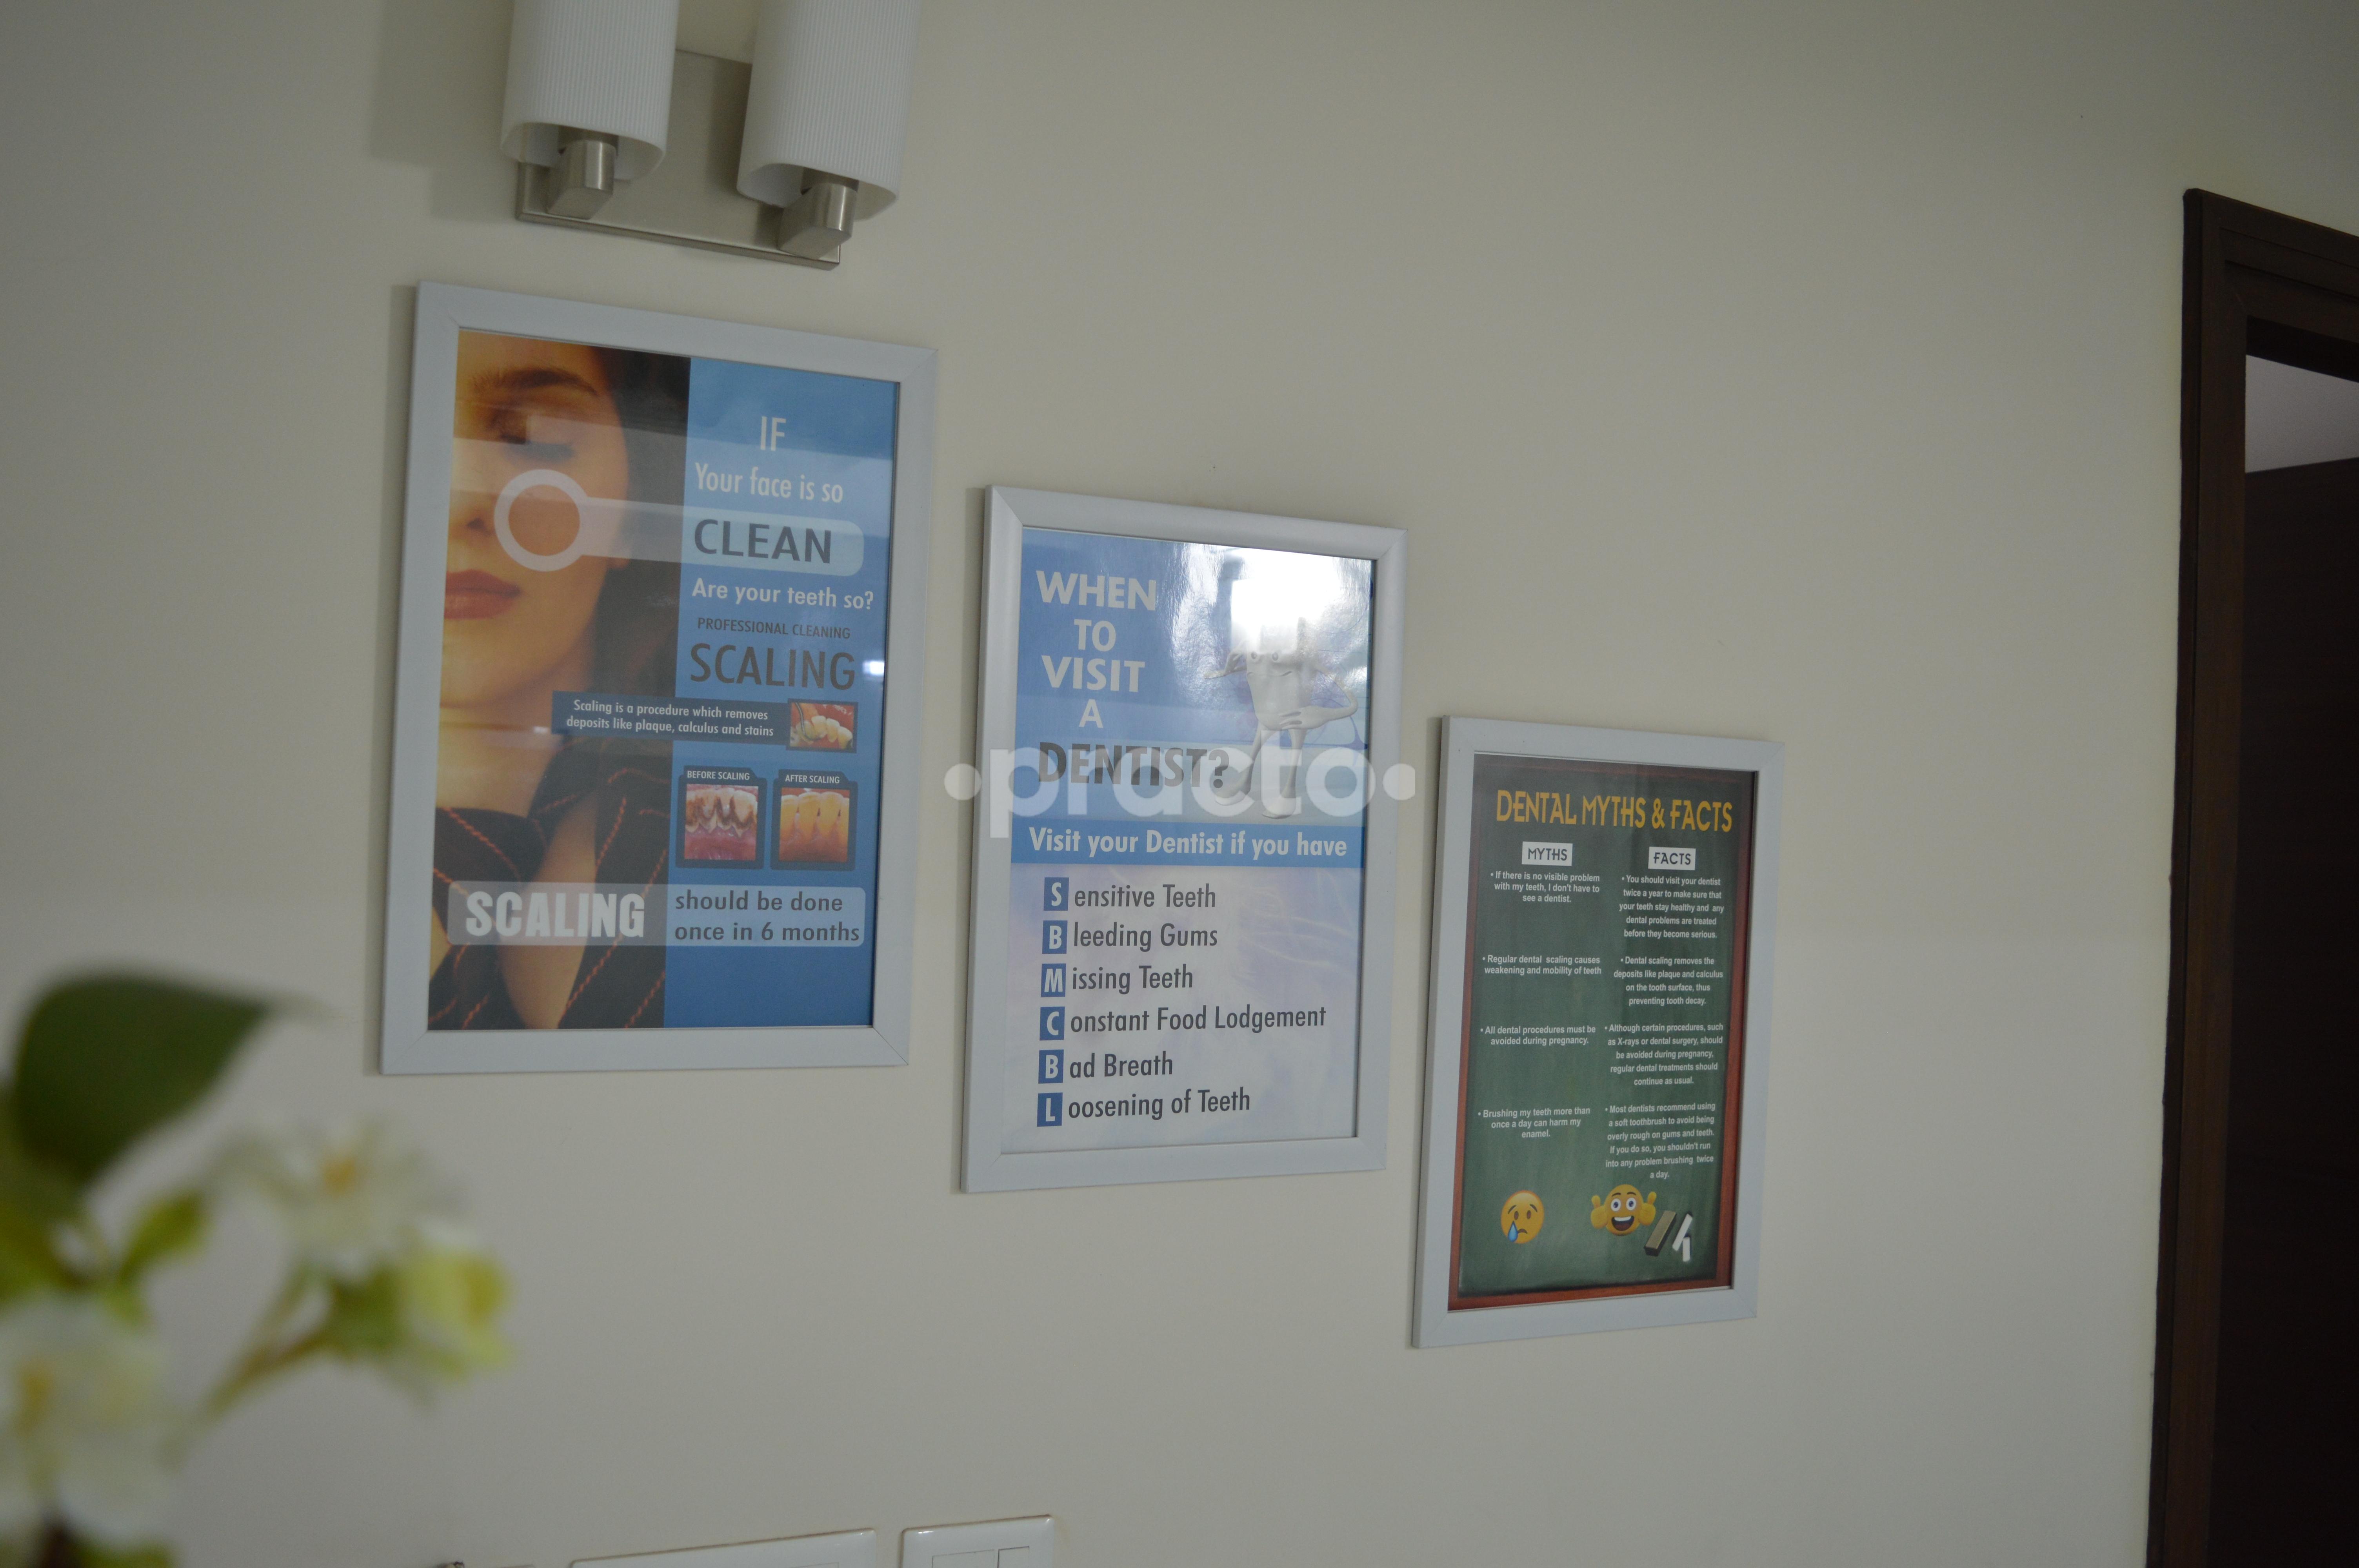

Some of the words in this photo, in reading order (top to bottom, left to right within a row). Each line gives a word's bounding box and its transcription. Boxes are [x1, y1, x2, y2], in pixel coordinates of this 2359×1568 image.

[760, 416, 787, 452] IF
[695, 462, 743, 493] Your
[749, 466, 792, 498] face
[800, 474, 814, 500] is
[821, 483, 843, 503] so
[694, 518, 831, 564] CLEAN
[692, 577, 728, 599] Are
[735, 586, 781, 604] your
[787, 586, 836, 607] teeth
[844, 590, 873, 609] so?
[1036, 570, 1157, 611] WHEN
[698, 617, 789, 635] PROFESSIONAL
[792, 624, 850, 639] CLEANING
[1074, 619, 1116, 652] TO
[690, 642, 855, 690] SCALING
[1041, 655, 1145, 692] VISIT
[574, 699, 612, 715] Scaling
[615, 704, 623, 713] is
[637, 704, 689, 716] procedure
[692, 705, 722, 717] which
[725, 710, 768, 720] removes
[1078, 699, 1103, 728] A
[566, 715, 609, 729] deposits
[612, 717, 632, 730] like
[635, 719, 674, 733] plaque,
[678, 721, 718, 733] calculus
[721, 723, 741, 735] and
[744, 726, 773, 736] stains
[687, 770, 716, 779] BEFORE
[718, 771, 750, 780] SCALING
[1038, 741, 1229, 789] DENTIST?
[785, 774, 807, 782] AFTER
[809, 775, 840, 784] SCALING
[1496, 789, 1577, 824] DENTAL
[1581, 795, 1646, 828] MYTHS
[1651, 798, 1665, 829] &
[1670, 799, 1732, 832] FACTS
[1029, 827, 1081, 851] Visit
[1087, 835, 1138, 857] your
[1146, 829, 1223, 854] Dentist
[1230, 830, 1245, 854] if
[1251, 838, 1289, 860] you
[1297, 831, 1347, 856] have
[1528, 848, 1567, 861] MYTHS
[1653, 852, 1691, 865] FACTS
[1495, 870, 1501, 878] If
[1502, 871, 1522, 879] there
[1524, 871, 1530, 880] is
[1544, 872, 1568, 881] visible
[1570, 873, 1600, 883] problem
[1625, 875, 1639, 883] You
[1641, 875, 1664, 884] should
[1665, 876, 1680, 884] visit
[1681, 878, 1697, 886] your
[1697, 877, 1721, 886] dentist
[1162, 883, 1216, 907] Teeth
[1512, 884, 1523, 892] my
[1525, 883, 1546, 892] teeth,
[1552, 883, 1571, 892] don't
[1573, 884, 1590, 892] have
[1544, 894, 1571, 902] dentist.
[676, 889, 748, 910] should
[758, 890, 782, 911] be
[791, 891, 842, 911] done
[1619, 903, 1635, 911] your
[1654, 903, 1669, 912] stay
[1670, 903, 1695, 913] healthy
[1712, 906, 1724, 914] any
[465, 891, 645, 938] SCALING
[1625, 915, 1647, 924] dental
[1648, 916, 1680, 925] problems
[675, 926, 724, 940] once
[733, 922, 752, 940] in
[761, 921, 773, 940] 6
[782, 921, 859, 941] months
[1160, 922, 1217, 946] Gums
[1623, 929, 1645, 937] before
[1647, 929, 1661, 939] they
[1487, 954, 1517, 965] Regular
[1518, 955, 1542, 963] dental
[1546, 955, 1572, 965] scaling
[1625, 956, 1647, 964] Dental
[1648, 956, 1672, 966] scaling
[1138, 964, 1193, 988] Teeth
[1484, 966, 1525, 976] weakening
[1527, 966, 1541, 974] and
[1543, 966, 1572, 976] mobility
[1574, 966, 1582, 974] of
[1157, 1004, 1206, 1030] Food
[1215, 1004, 1326, 1033] Lodgement
[1484, 1025, 1495, 1034] All
[1497, 1025, 1521, 1034] dental
[1522, 1025, 1565, 1035] procedures
[1490, 1036, 1521, 1045] avoided
[1522, 1036, 1547, 1046] during
[1548, 1037, 1588, 1046] pregnancy.
[1104, 1050, 1172, 1077] Breath
[1171, 1088, 1191, 1113] of
[1197, 1086, 1249, 1112] Teeth
[1627, 1104, 1655, 1112] dentists
[1656, 1102, 1696, 1111] recommend
[1697, 1102, 1715, 1111] using
[1483, 1109, 1518, 1118] Brushing
[1519, 1110, 1531, 1118] my
[1532, 1107, 1551, 1116] teeth
[1574, 1106, 1590, 1114] than
[1518, 1119, 1532, 1129] day
[1570, 1119, 1581, 1127] my
[1656, 1170, 1669, 1179] day.
